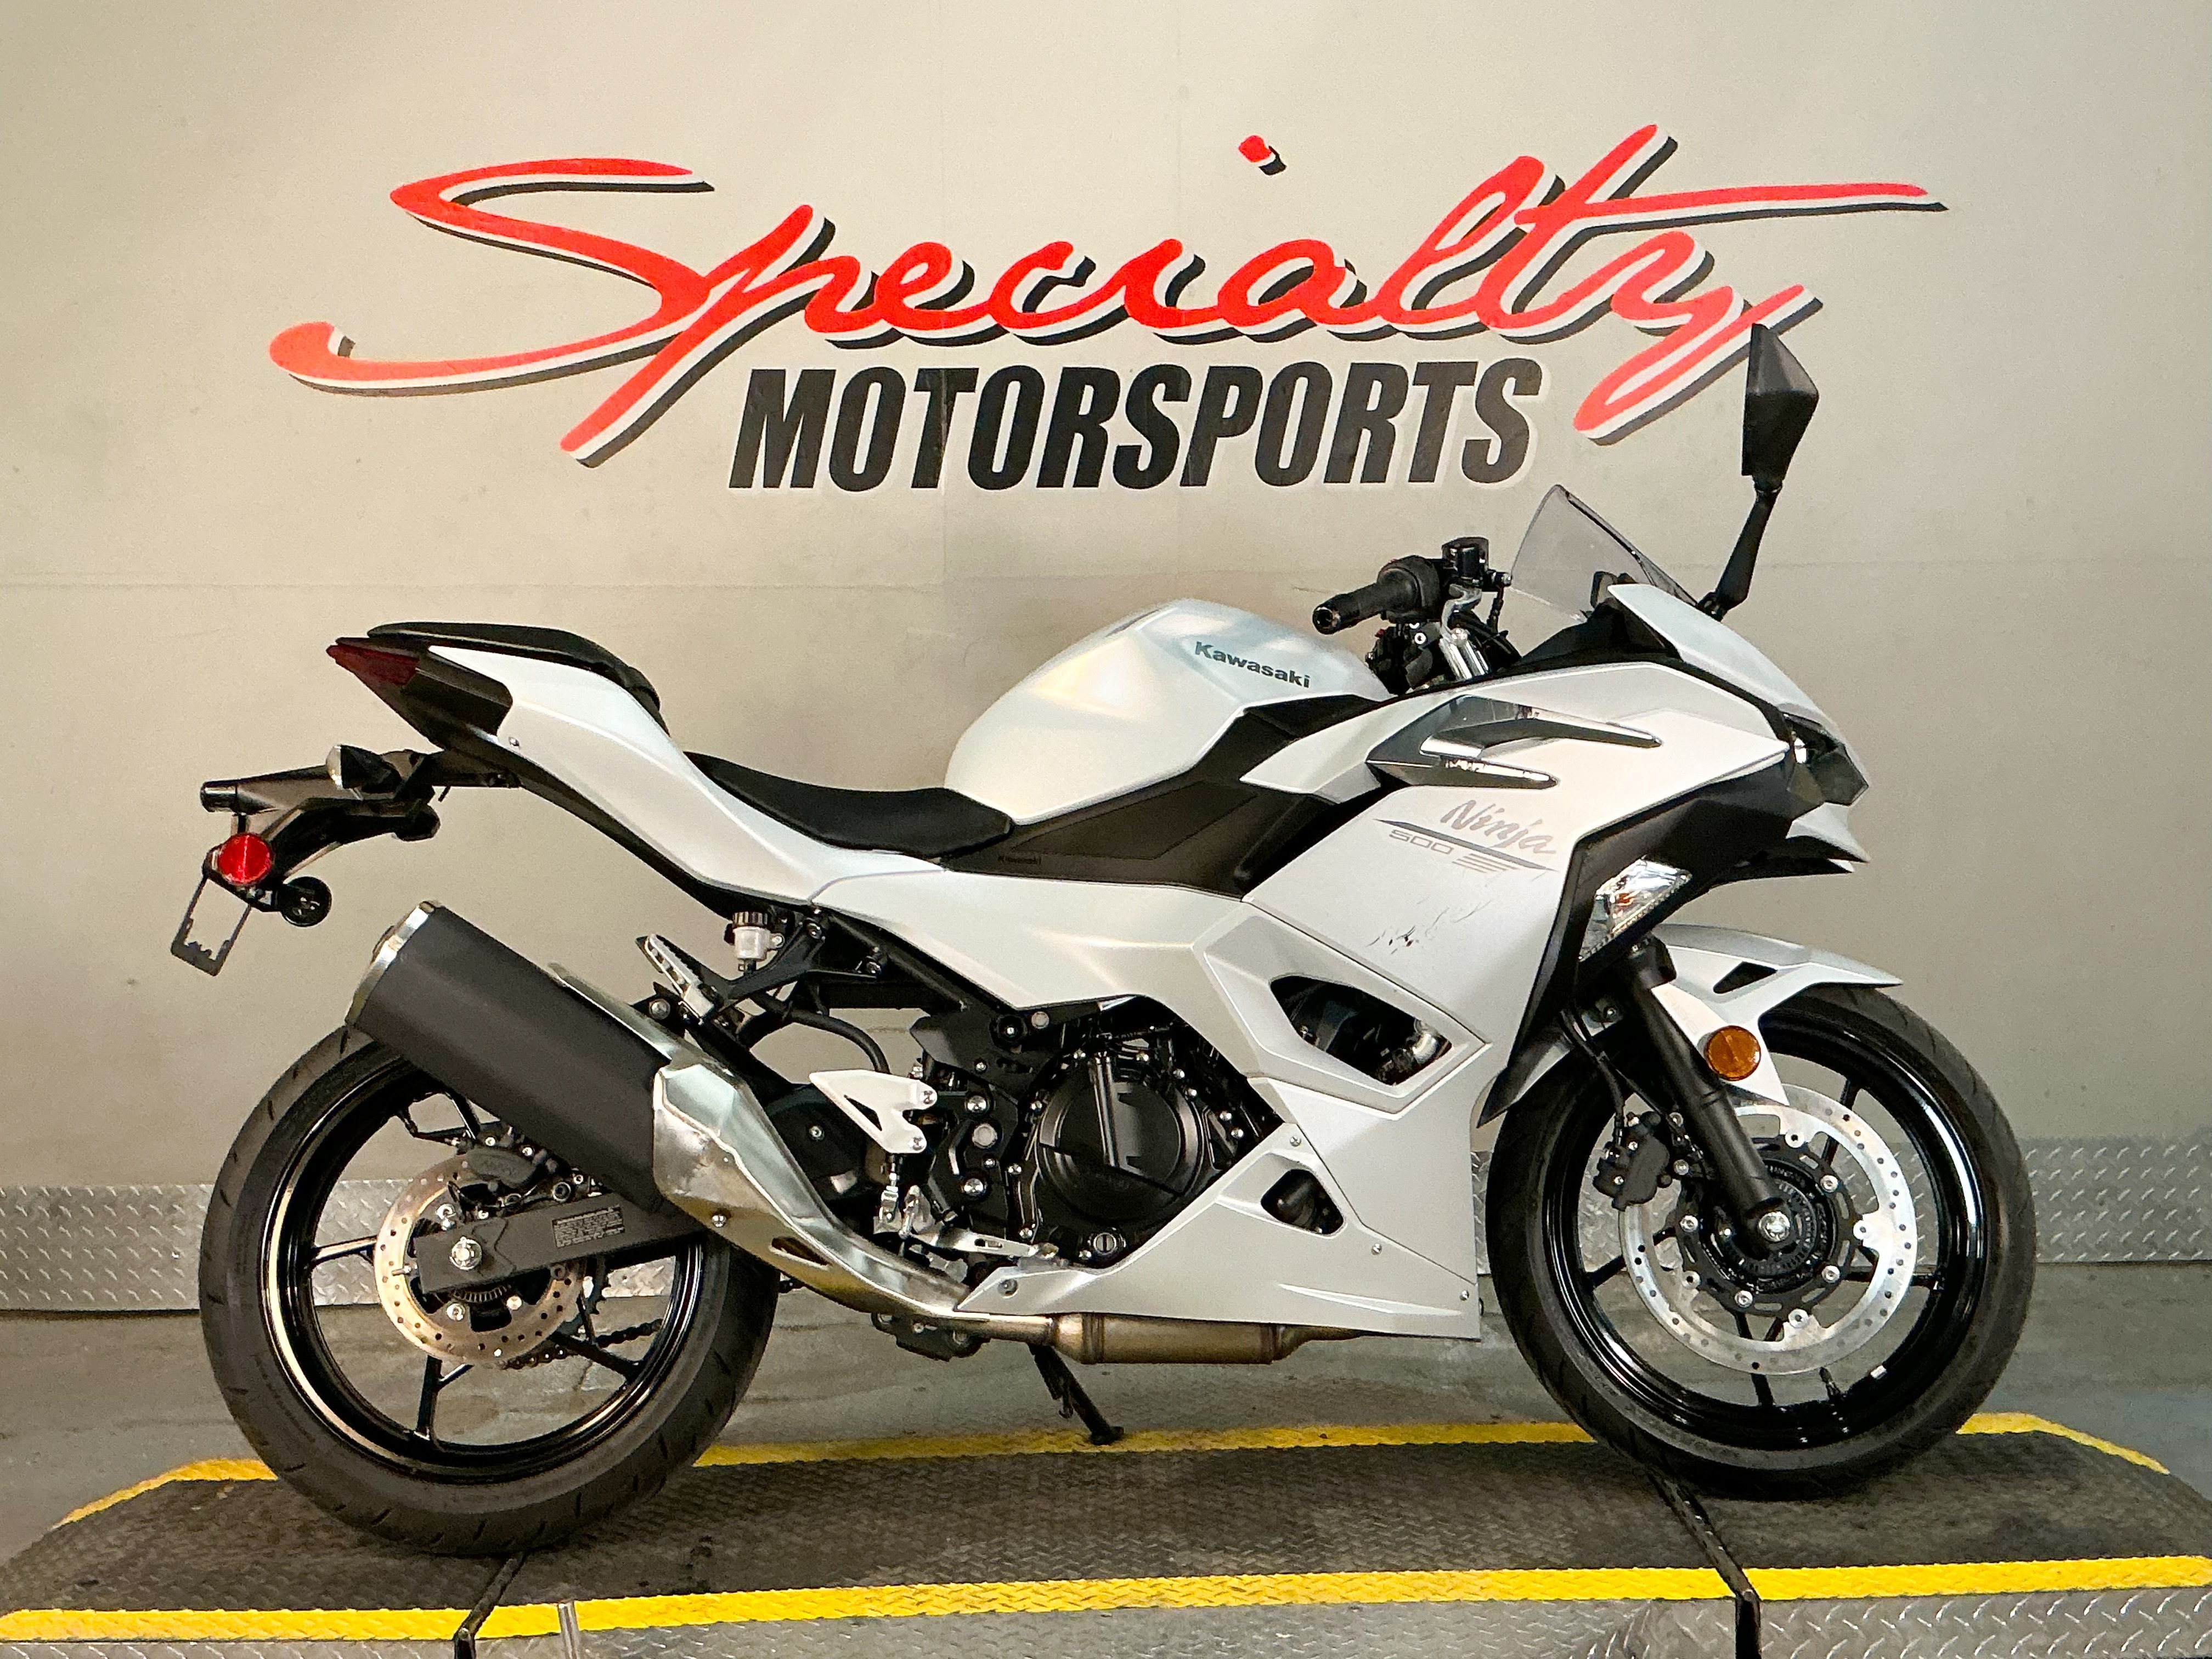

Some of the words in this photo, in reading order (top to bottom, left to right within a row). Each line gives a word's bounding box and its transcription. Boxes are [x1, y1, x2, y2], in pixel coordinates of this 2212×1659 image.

[269, 124, 1949, 467] Specialty
[728, 358, 1542, 492] MOTORSPORTS
[1195, 641, 1311, 689] Kawasaki
[1389, 828, 1454, 855] 500
[1440, 799, 1557, 854] Ninja
